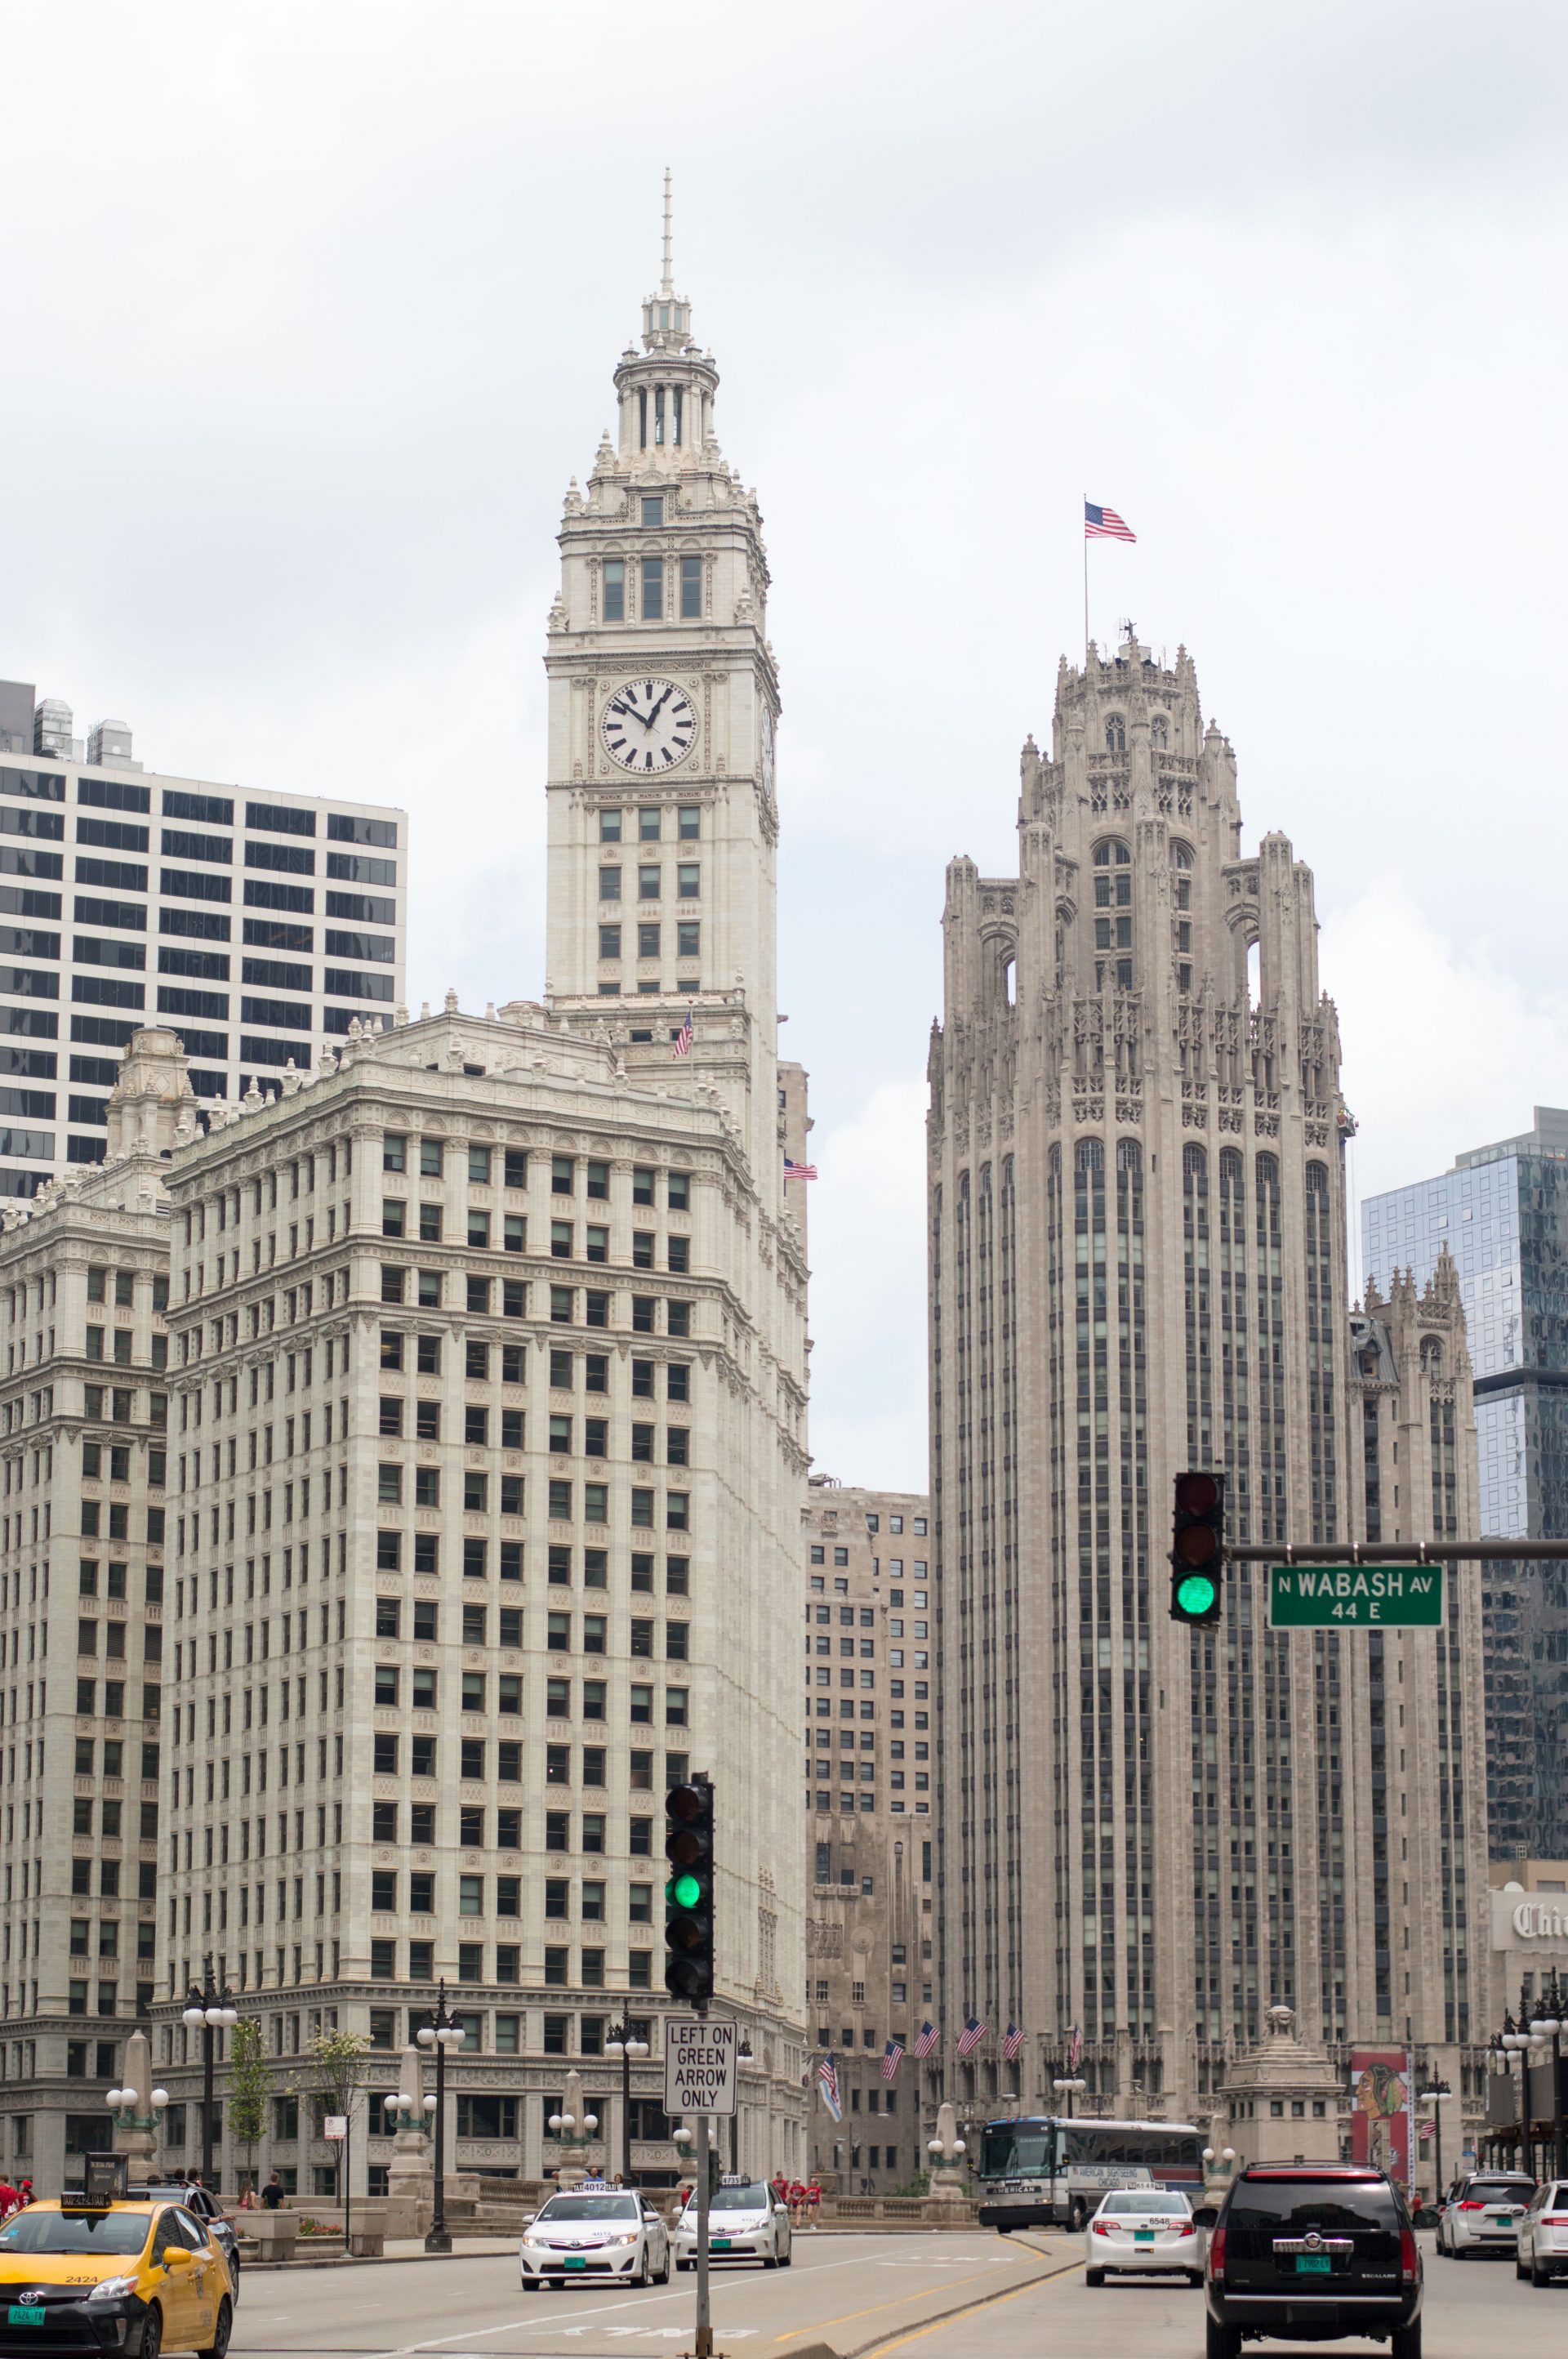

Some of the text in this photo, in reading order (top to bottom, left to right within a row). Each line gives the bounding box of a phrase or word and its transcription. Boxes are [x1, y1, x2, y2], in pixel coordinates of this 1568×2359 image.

[1278, 1572, 1433, 1597] N WABASH AV
[1331, 1603, 1381, 1619] 44 E
[671, 2027, 732, 2045] LEFT ON
[677, 2048, 725, 2065] GREEN
[675, 2069, 727, 2086] ARROW
[681, 2090, 718, 2107] ONLY
[1080, 2167, 1138, 2178] AMERICAN SIGHTSEEING
[584, 2183, 605, 2191] 4012
[1098, 2178, 1120, 2187] CHICAGO
[63, 2195, 105, 2205] TAXI 2424 TAXI
[13, 2310, 43, 2321] 2424 TX
